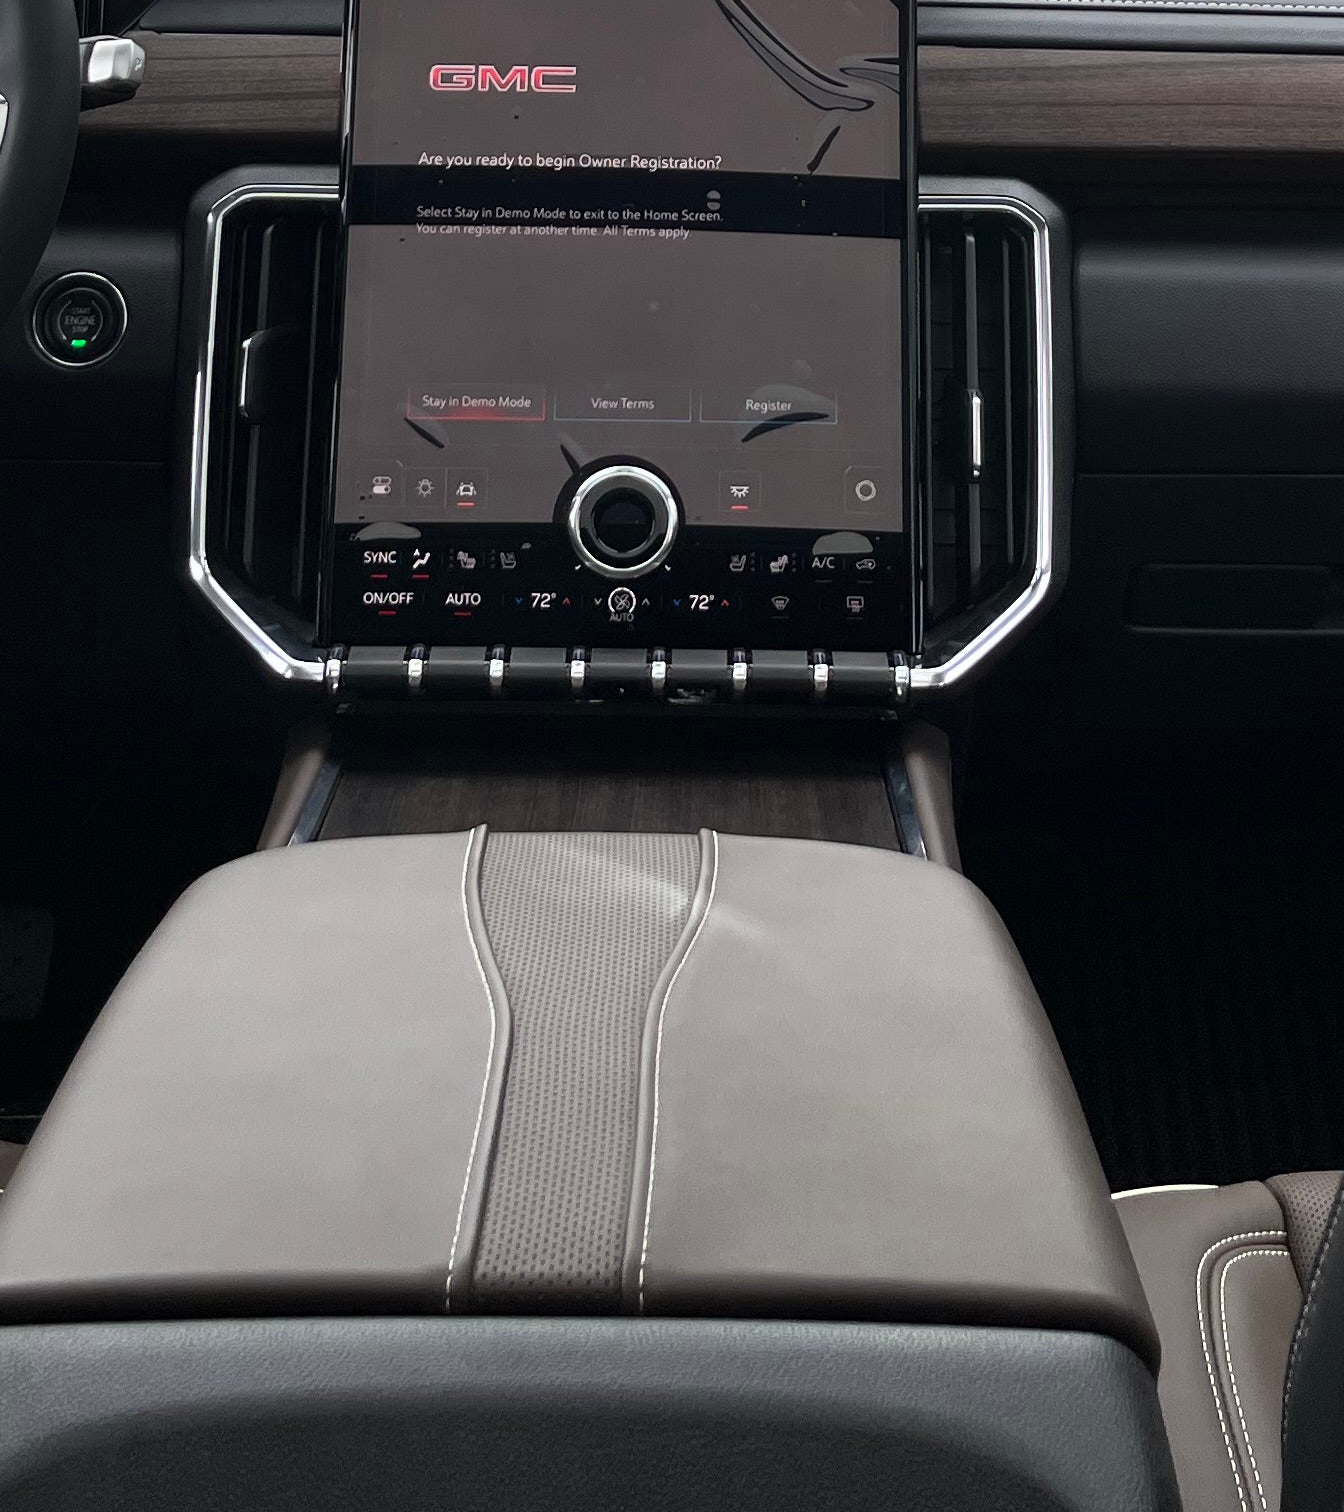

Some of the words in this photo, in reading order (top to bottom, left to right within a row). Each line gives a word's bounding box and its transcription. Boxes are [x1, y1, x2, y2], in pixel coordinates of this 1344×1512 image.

[429, 64, 577, 93] GMC
[418, 152, 443, 166] Are
[446, 155, 472, 170] you
[476, 152, 515, 170] ready
[518, 154, 533, 167] to
[536, 152, 575, 171] begin
[579, 153, 627, 168] Owner
[630, 155, 722, 172] Registration?
[416, 205, 453, 218] Select
[454, 205, 480, 221] Stay
[482, 206, 492, 218] in
[495, 206, 531, 219] Demo
[533, 207, 566, 219] Mode
[569, 208, 581, 220] to
[584, 208, 605, 220] exit
[607, 209, 620, 220] to
[622, 208, 641, 220] the
[644, 209, 679, 221] Home
[681, 209, 724, 222] Screen.
[415, 222, 437, 234] You
[439, 225, 460, 234] can
[463, 223, 507, 237] register
[509, 226, 522, 235] at
[523, 224, 569, 235] another
[603, 224, 618, 236] All
[621, 225, 656, 237] Terms
[64, 315, 96, 326] ENGINE
[422, 394, 447, 410] Stay
[448, 395, 459, 407] in
[462, 395, 496, 408] Demo
[498, 396, 532, 408] Mode
[591, 397, 618, 410] View
[621, 398, 655, 410] Terms
[745, 399, 792, 414] Register
[363, 550, 397, 564] SYNC
[811, 556, 836, 569] A/C
[362, 591, 414, 605] ON/OFF
[445, 592, 482, 606] AUTO
[609, 612, 634, 622] AUTO
